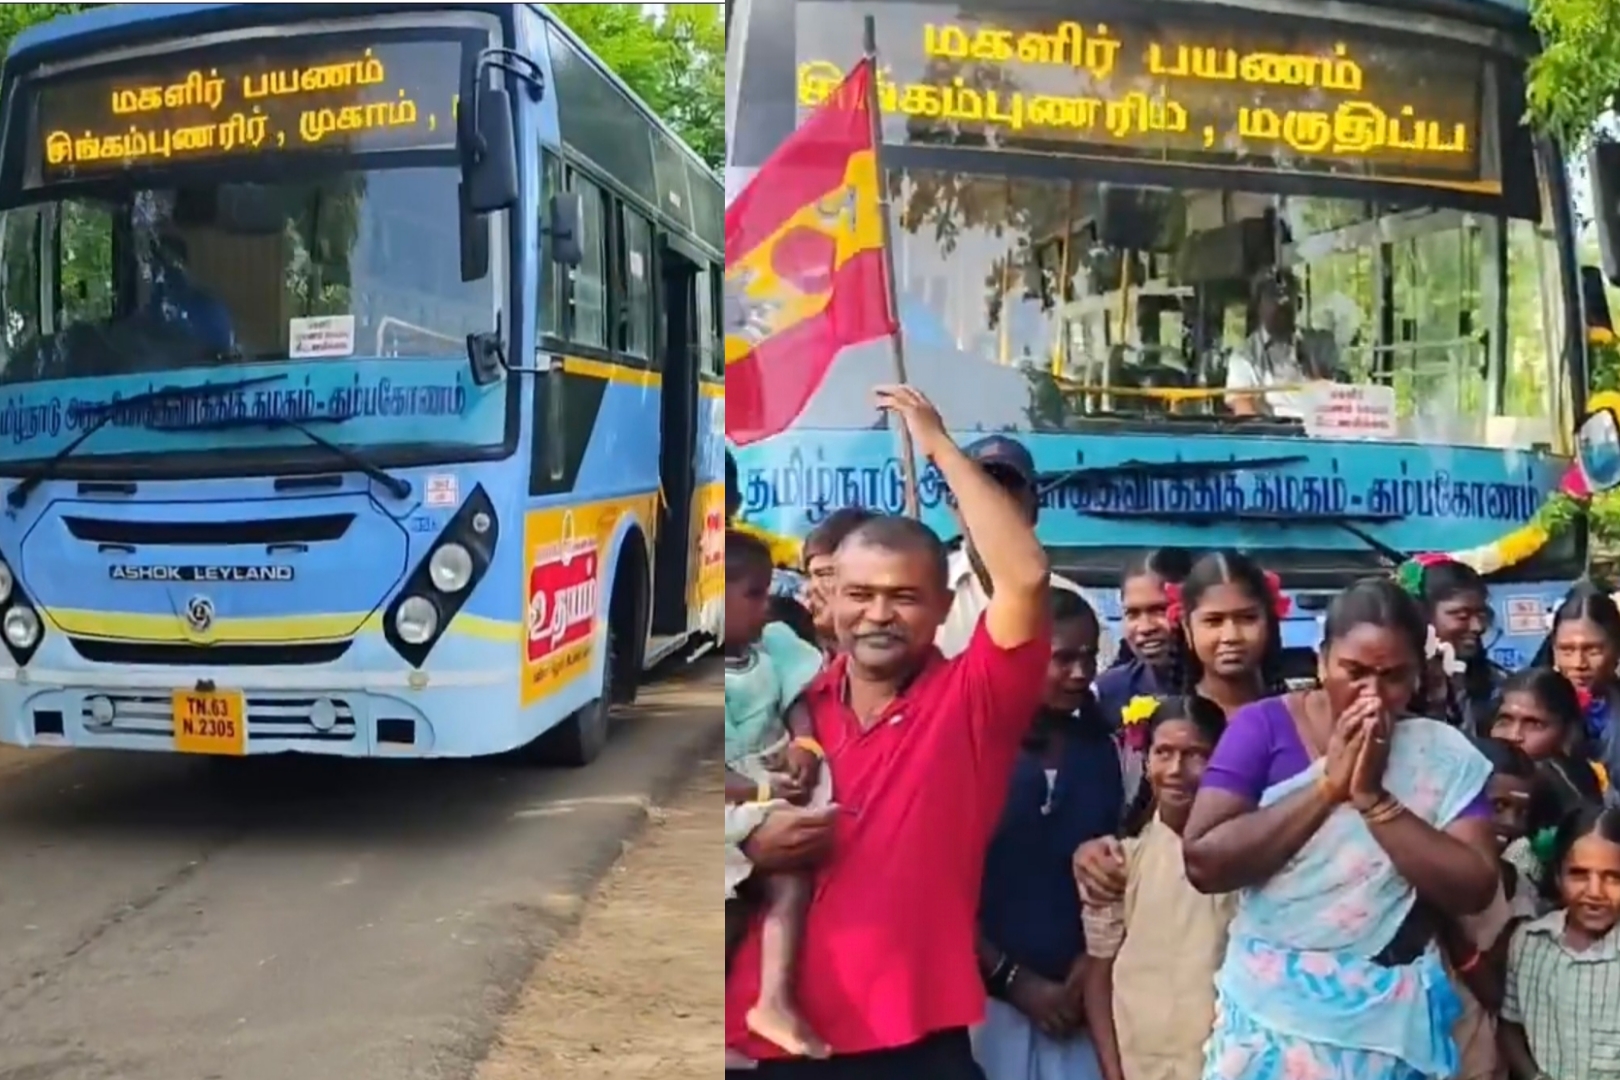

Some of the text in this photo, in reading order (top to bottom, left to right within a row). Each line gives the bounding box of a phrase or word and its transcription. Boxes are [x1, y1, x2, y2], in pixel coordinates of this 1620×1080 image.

[112, 47, 385, 114] மகளிர் பயணம்
[924, 21, 1363, 91] மகளிர் பயணம்
[112, 566, 293, 581] ASHOK LEYLAND
[529, 555, 597, 650] உதயம்
